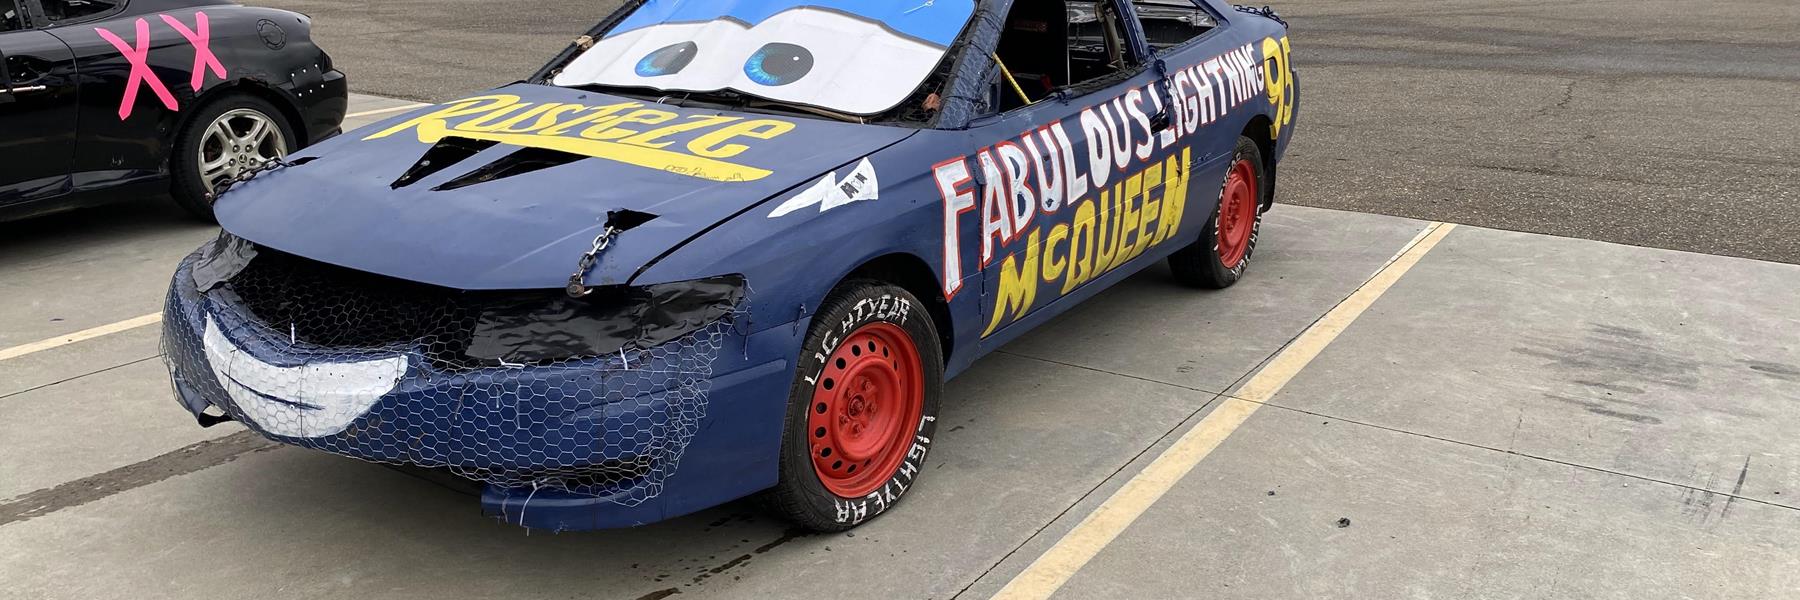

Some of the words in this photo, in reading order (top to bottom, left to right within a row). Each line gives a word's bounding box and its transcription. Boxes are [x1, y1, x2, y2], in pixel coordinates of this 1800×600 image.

[1262, 36, 1295, 140] 95
[932, 87, 1154, 301] FABULOUS
[1148, 43, 1265, 149] LIGHTNING
[804, 294, 911, 386] LIGHTYEAR
[834, 415, 936, 525] LIGHTYEAR
